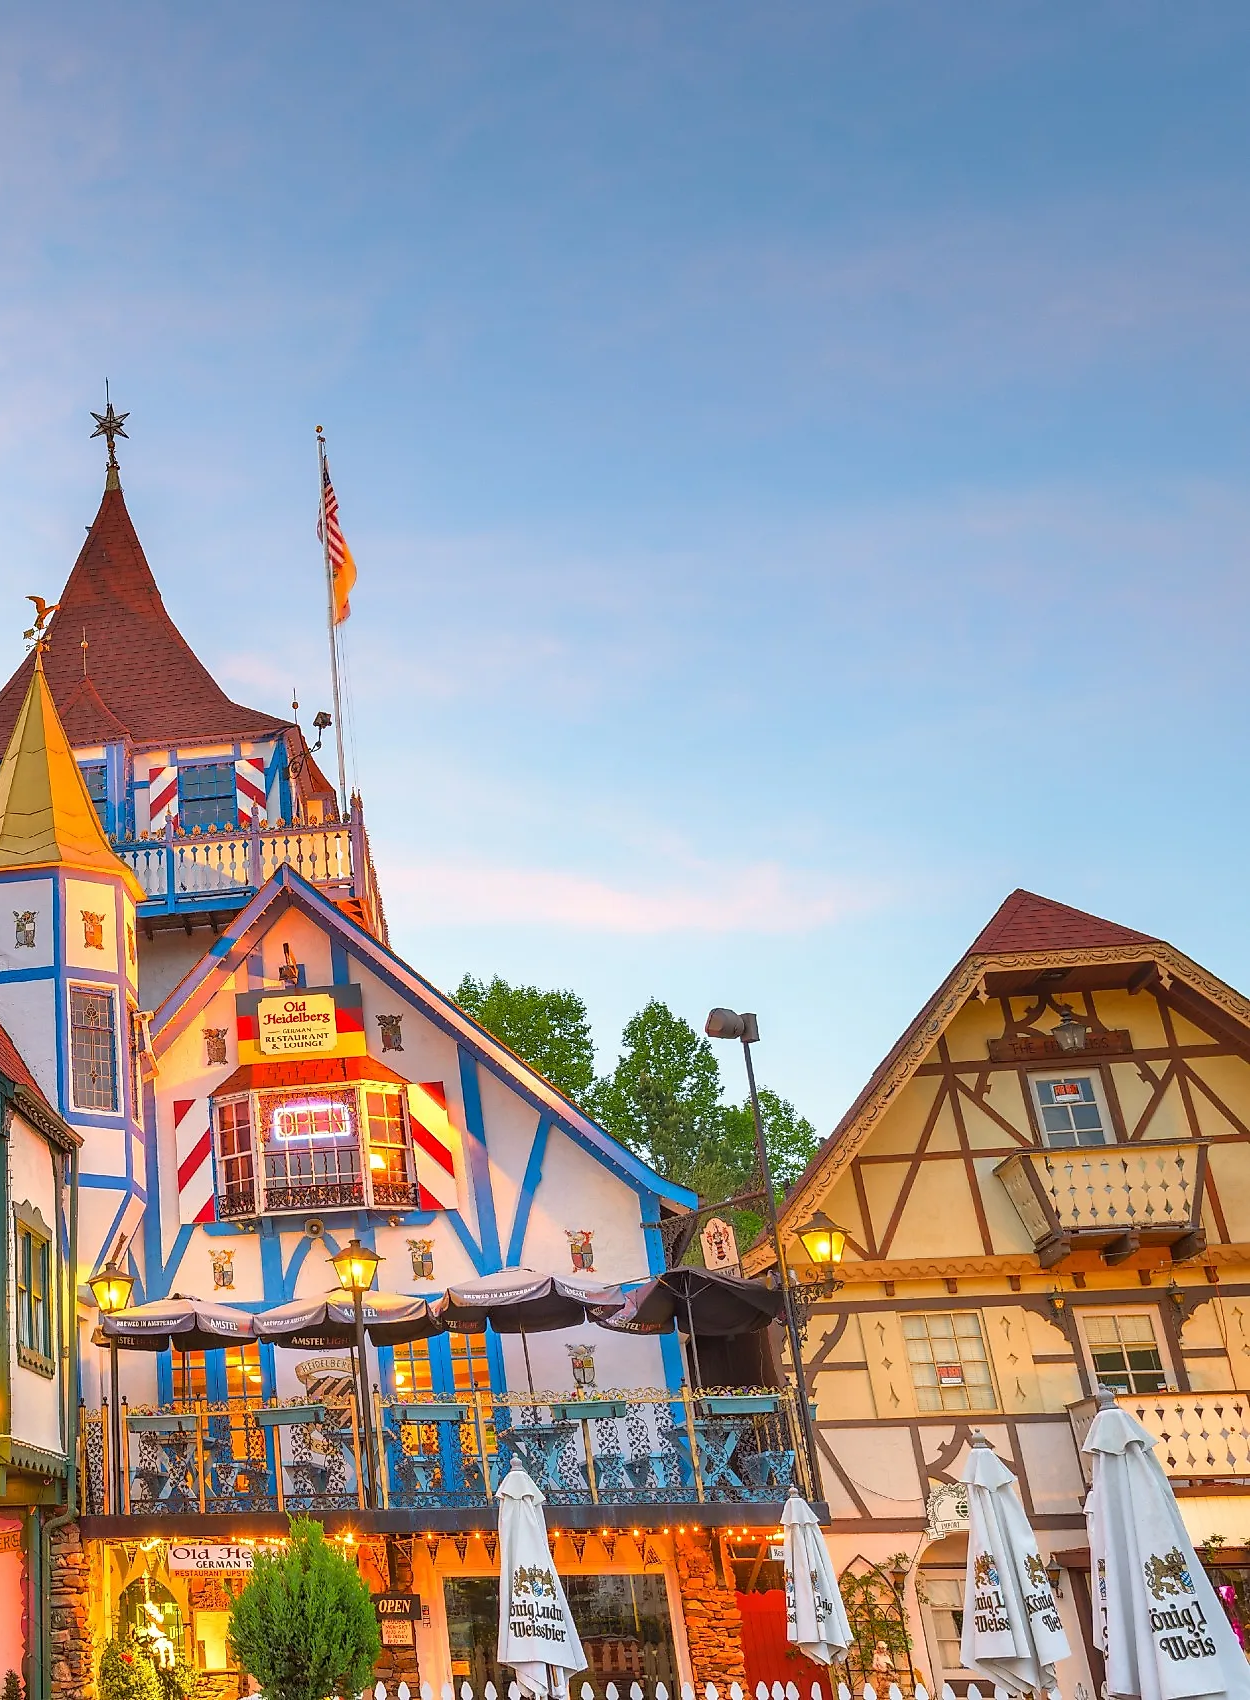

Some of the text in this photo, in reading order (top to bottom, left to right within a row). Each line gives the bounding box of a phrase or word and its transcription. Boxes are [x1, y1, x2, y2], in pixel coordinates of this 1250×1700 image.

[283, 1001, 307, 1013] Old
[263, 1012, 331, 1025] Heidelberg
[282, 1027, 312, 1035] GERMAN
[265, 1032, 330, 1043] RESTAURANT
[283, 1041, 324, 1049] LOUNGE
[1054, 1084, 1066, 1095] FOR
[278, 1106, 346, 1137] OPEN
[343, 1308, 378, 1318] AMTEL
[116, 1320, 140, 1328] BREWED
[210, 1318, 238, 1331] AMSTEL
[291, 1336, 325, 1346] AMSTEL
[172, 1547, 210, 1560] Old
[195, 1560, 241, 1569] GERMAN
[378, 1599, 412, 1613] OPEN
[510, 1619, 566, 1643] Weissbier
